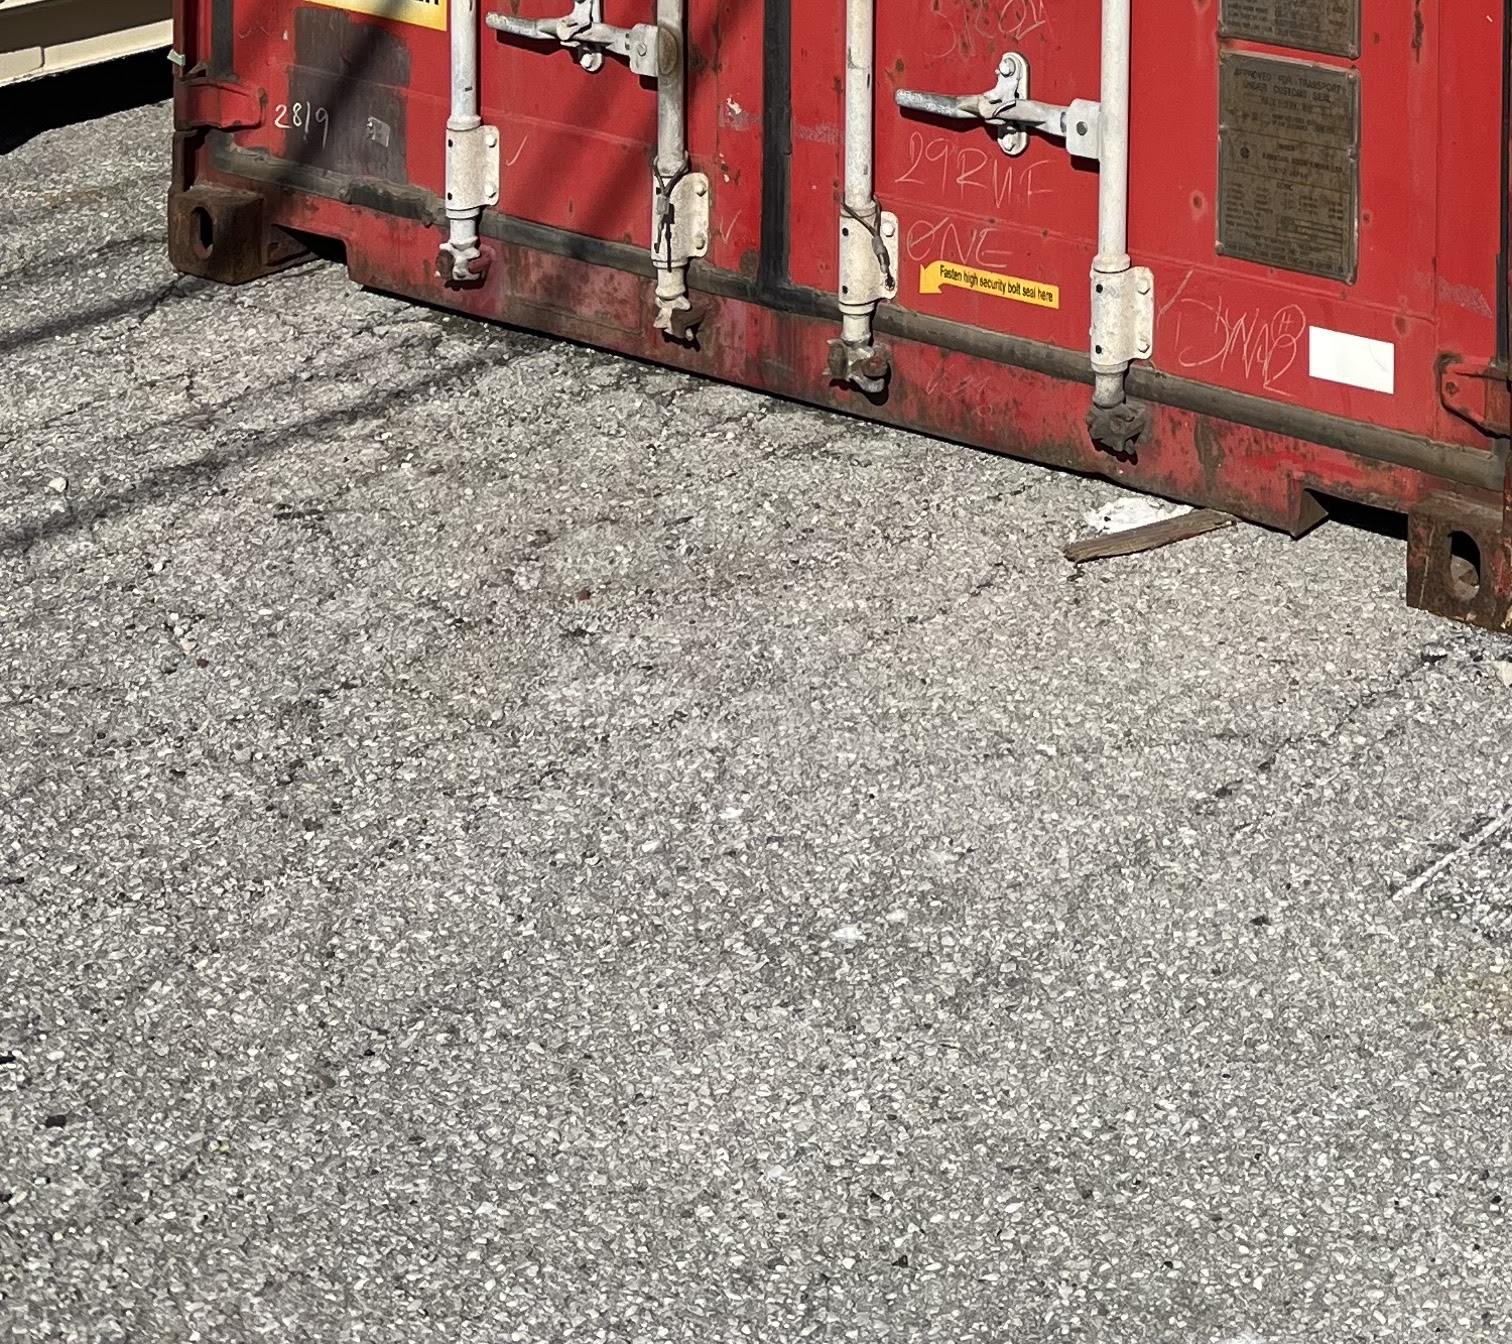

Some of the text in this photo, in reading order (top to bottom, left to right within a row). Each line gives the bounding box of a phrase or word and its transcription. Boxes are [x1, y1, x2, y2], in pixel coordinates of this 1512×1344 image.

[939, 264, 1053, 303] Fasten high security bolt seal here
